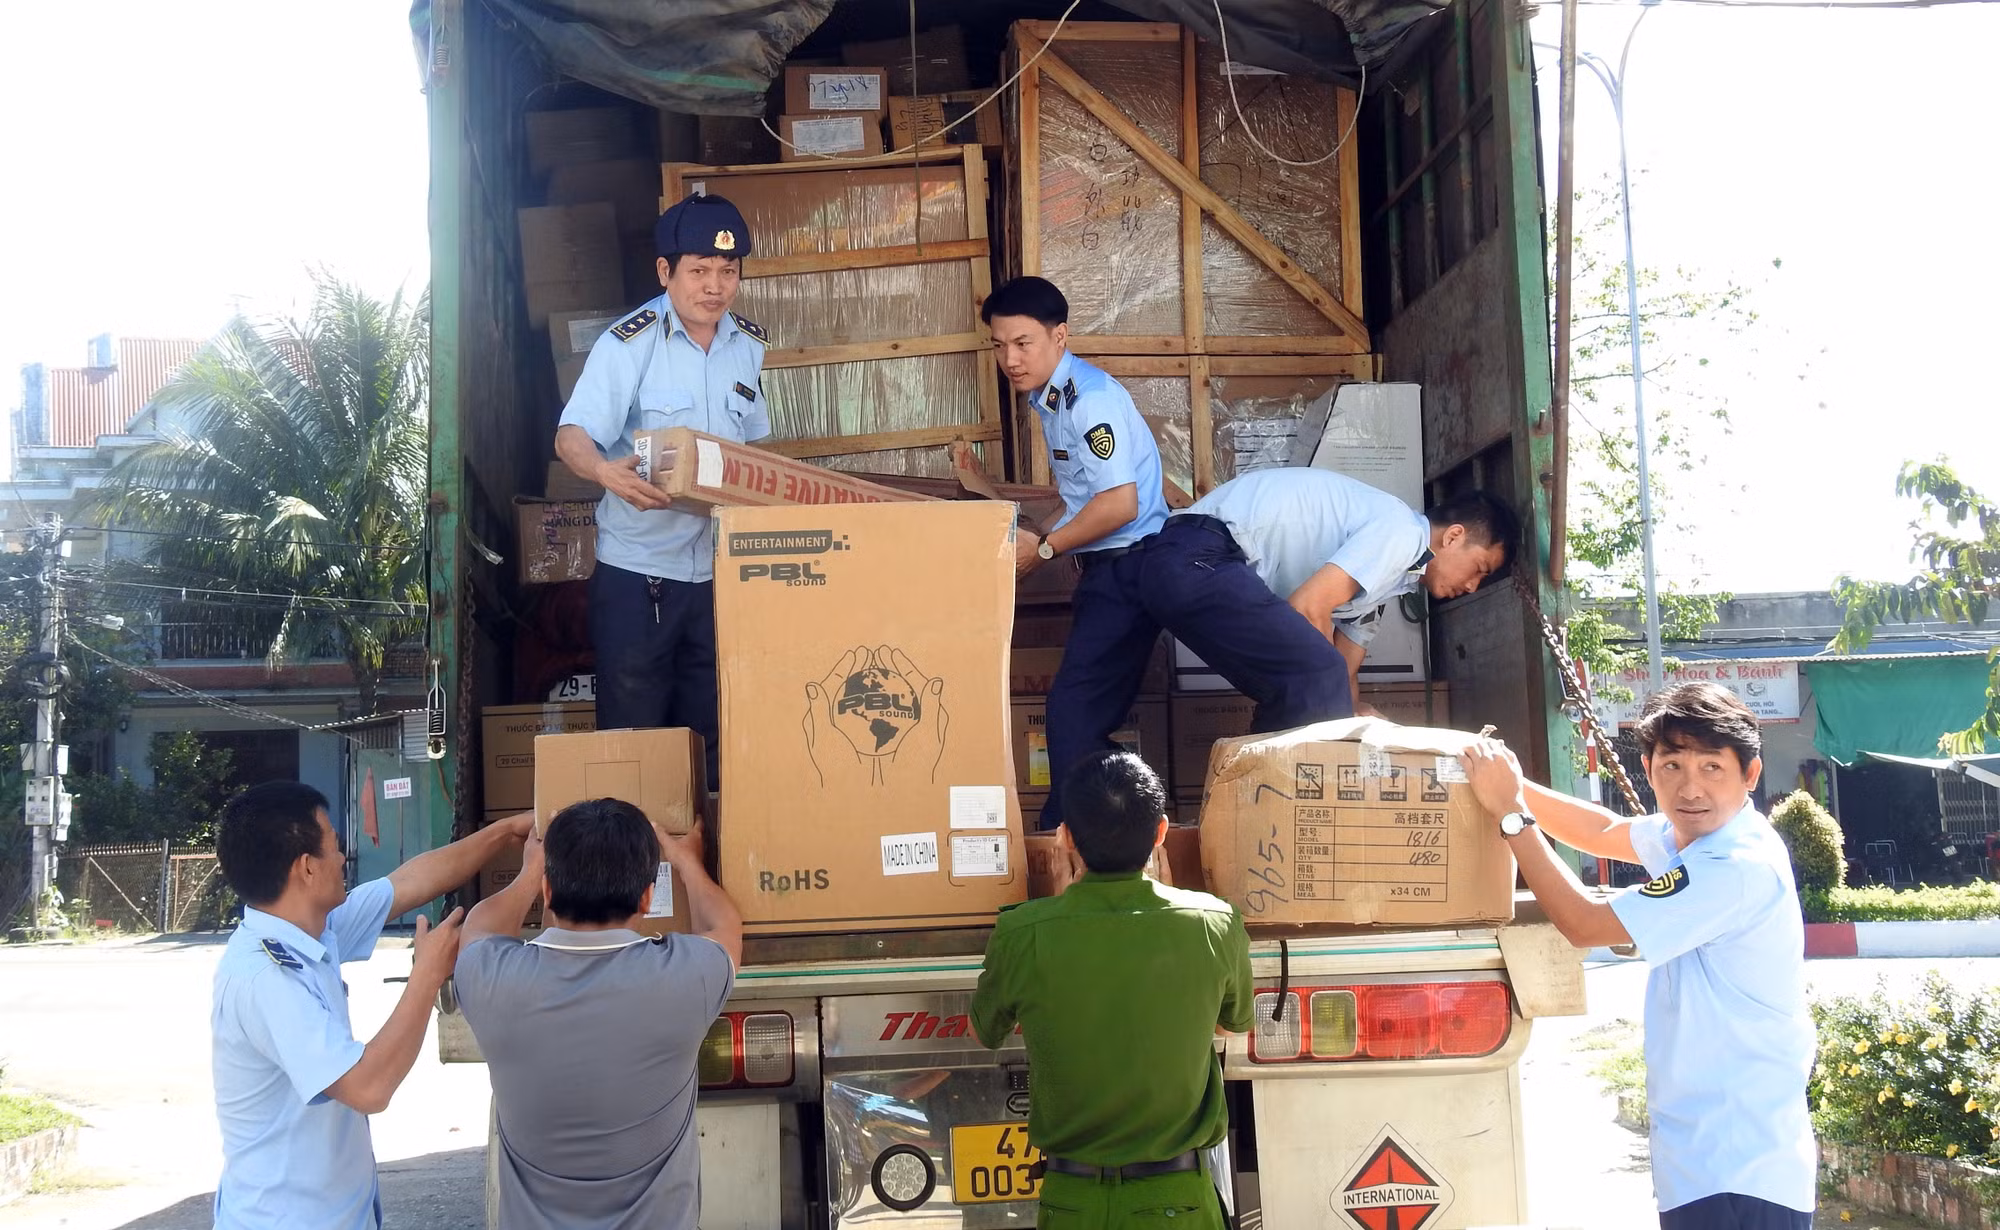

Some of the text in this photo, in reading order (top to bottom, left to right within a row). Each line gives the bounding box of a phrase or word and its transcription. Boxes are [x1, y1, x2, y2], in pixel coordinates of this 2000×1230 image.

[733, 536, 827, 550] ENTERTAINMENT
[740, 562, 827, 582] PBL
[1715, 665, 1731, 680] &
[838, 693, 913, 715] PBL
[1028, 715, 1045, 725] THU
[1395, 812, 1445, 825] 高档套尺
[1407, 830, 1441, 848] 1816
[884, 843, 904, 867] MADE
[904, 843, 914, 866] IN
[914, 842, 937, 865] CHINA
[760, 868, 830, 892] RoHS
[1413, 887, 1431, 897] CM
[879, 1011, 972, 1041] Tha
[997, 1127, 1030, 1159] 47
[971, 1163, 1035, 1198] 003
[1344, 1188, 1440, 1206] INTERNATIONAL
